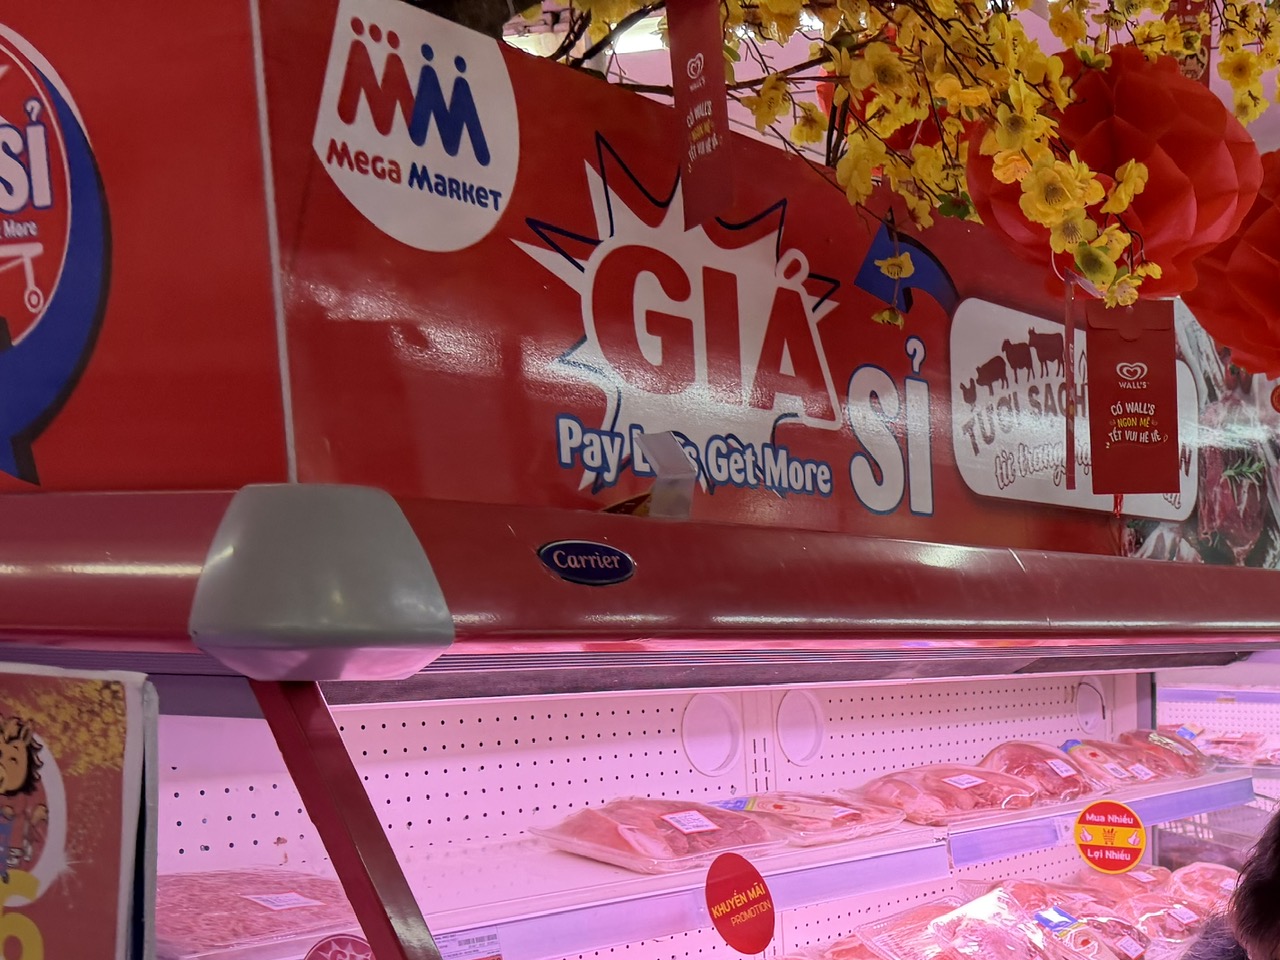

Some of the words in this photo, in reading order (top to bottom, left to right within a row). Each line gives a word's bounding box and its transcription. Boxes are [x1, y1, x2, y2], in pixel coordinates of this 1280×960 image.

[326, 138, 402, 184] Mega
[408, 162, 502, 211] Market
[3, 220, 38, 238] More
[1118, 381, 1147, 389] WALL'S
[1111, 401, 1123, 416] CÓ
[1125, 402, 1155, 416] WALL'S
[846, 336, 934, 516] SỈ
[1117, 417, 1137, 427] NGON
[1108, 427, 1122, 442] TẾT
[1125, 431, 1138, 442] VUI
[556, 413, 622, 488] Pay
[706, 432, 760, 484] Get
[763, 444, 833, 497] More
[553, 549, 621, 571] Carrier
[1085, 813, 1105, 822] Mua
[711, 889, 748, 919] KHUYẾN
[747, 882, 766, 900] MÃI
[730, 900, 772, 926] PROMOTION
